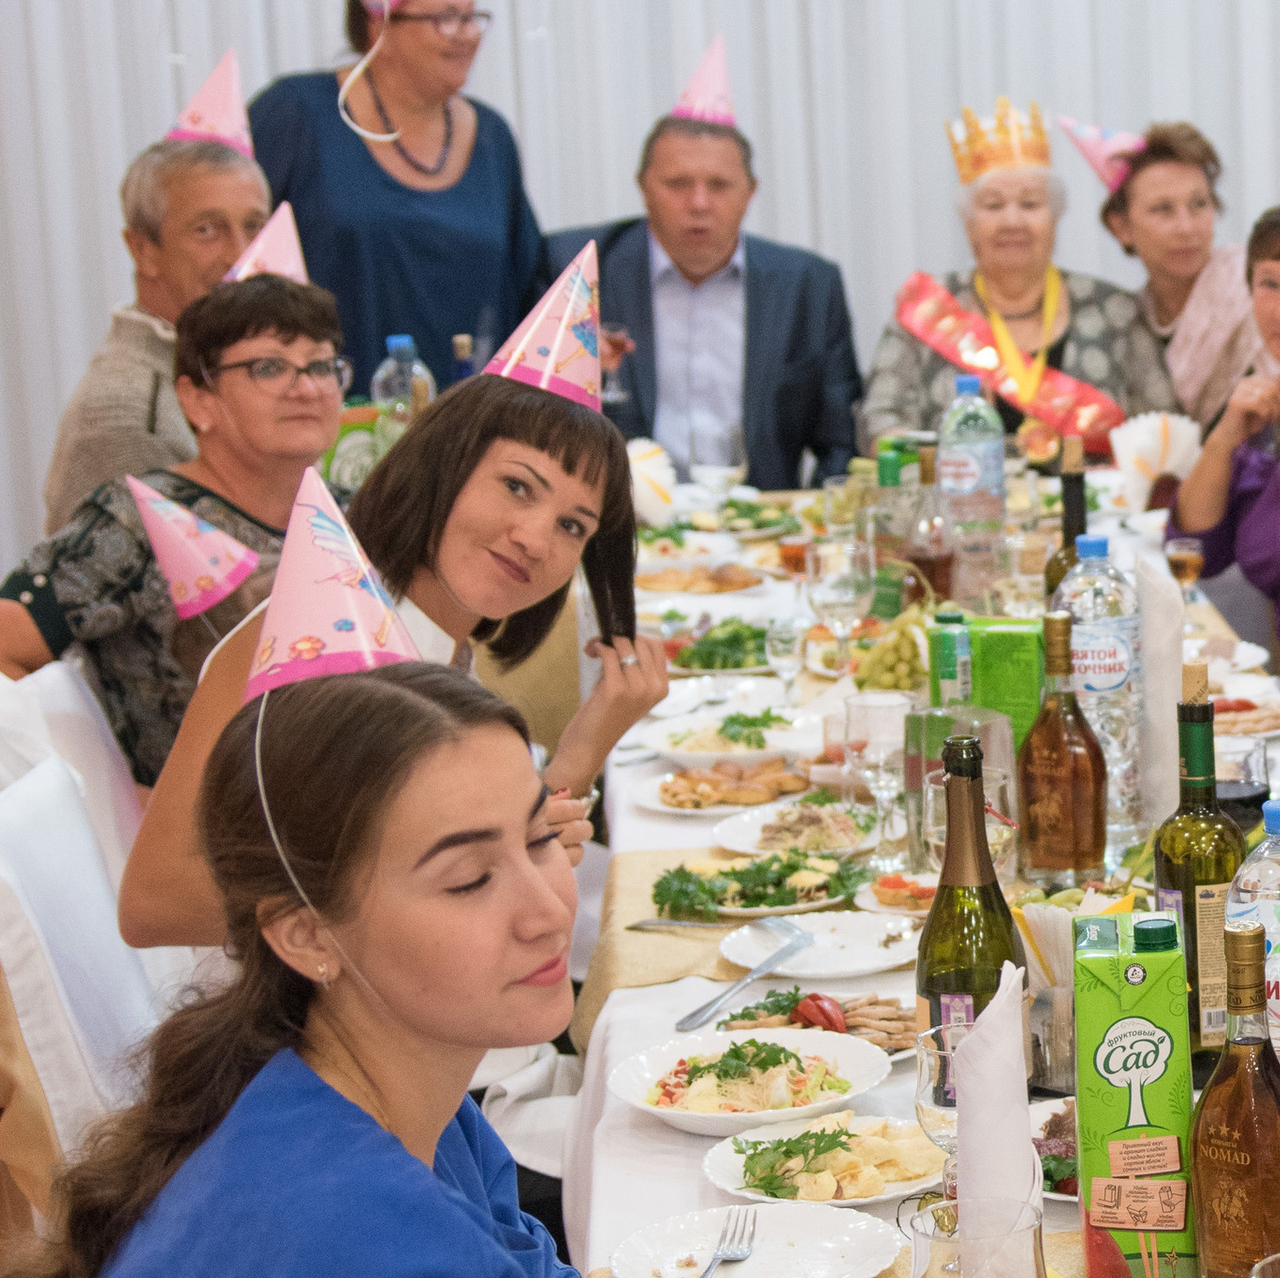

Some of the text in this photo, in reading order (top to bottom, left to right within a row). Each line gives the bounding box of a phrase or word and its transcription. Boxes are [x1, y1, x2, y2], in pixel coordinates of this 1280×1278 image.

[1107, 1030, 1156, 1047] фруктовый
[1103, 1039, 1160, 1074] Сад
[1200, 1144, 1250, 1166] NOMAD
